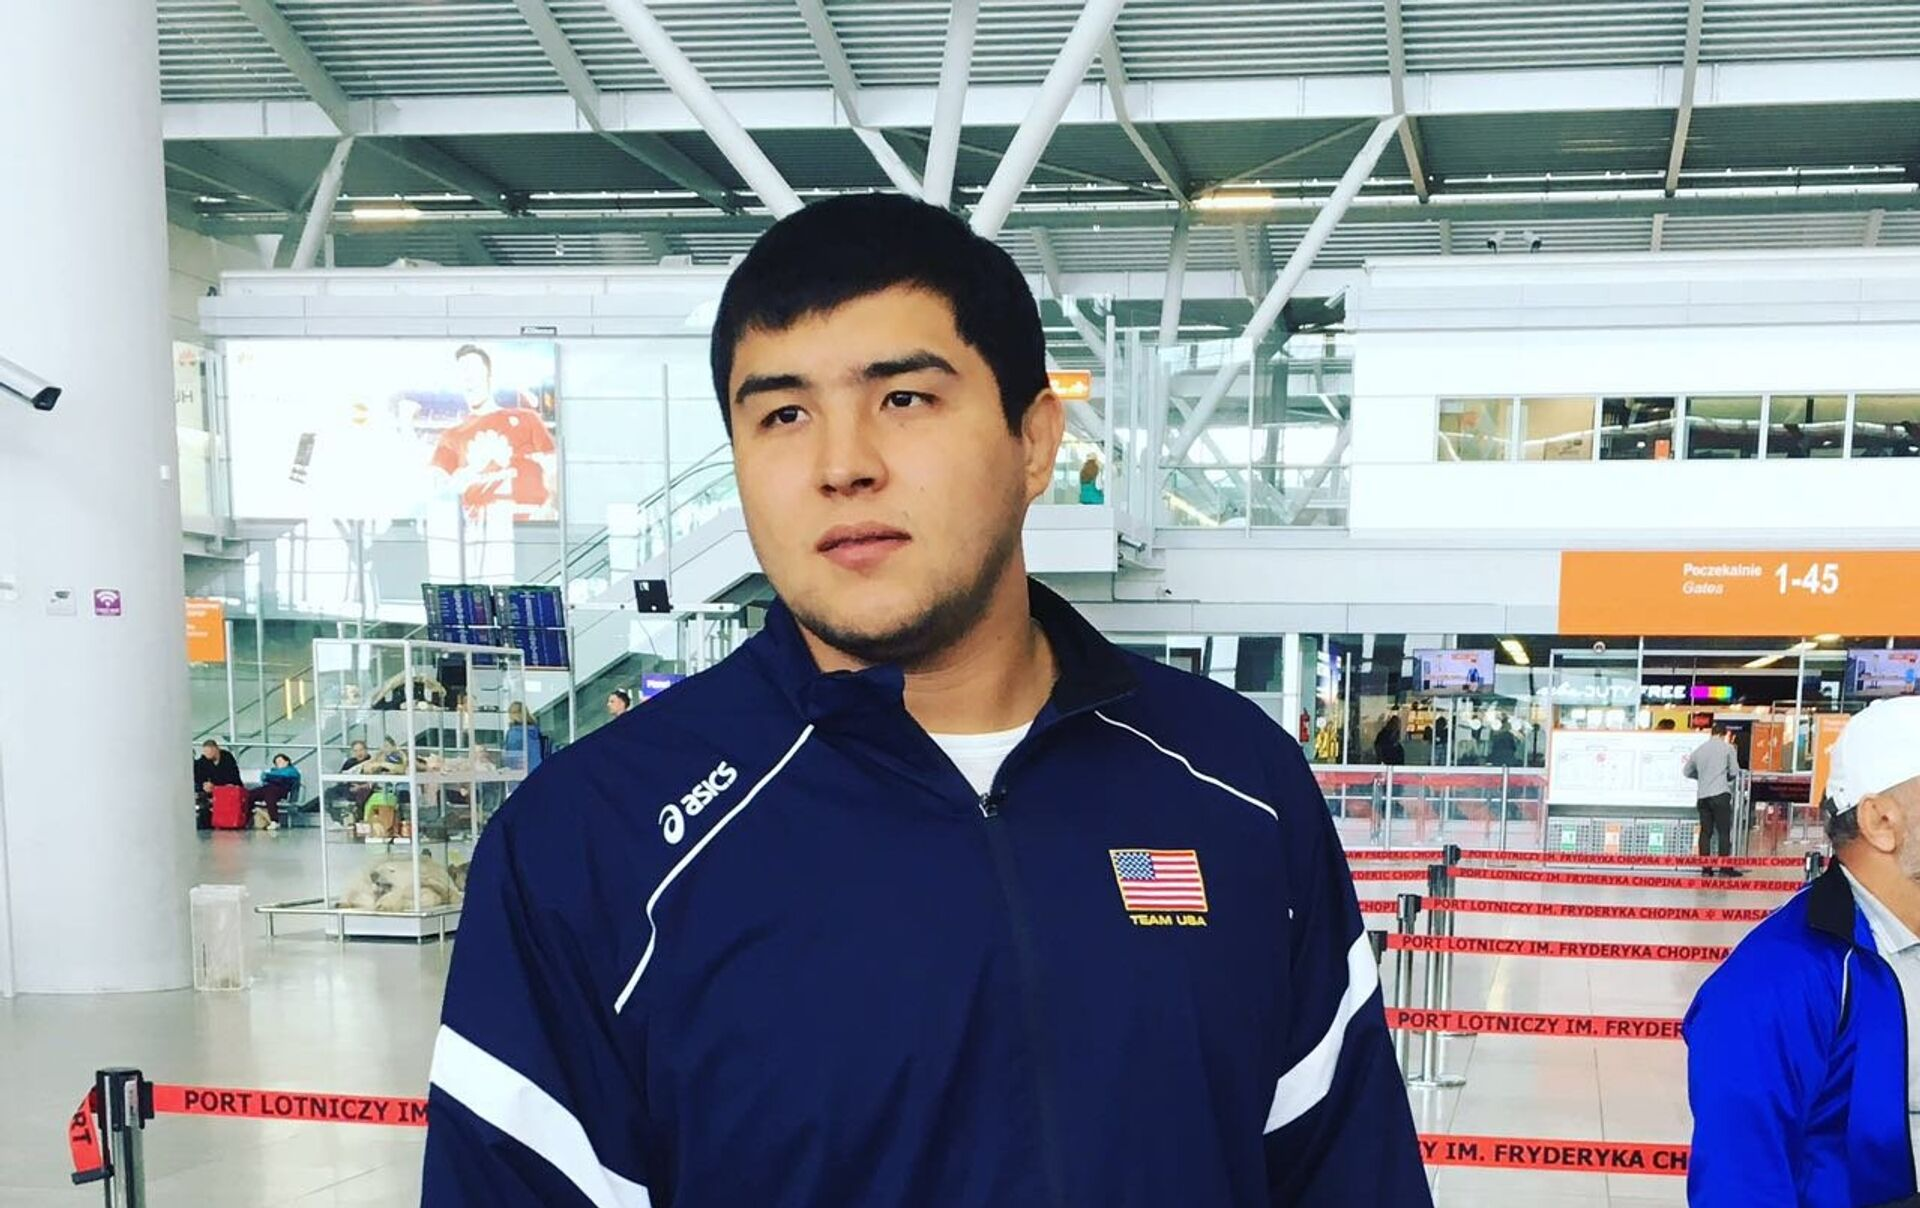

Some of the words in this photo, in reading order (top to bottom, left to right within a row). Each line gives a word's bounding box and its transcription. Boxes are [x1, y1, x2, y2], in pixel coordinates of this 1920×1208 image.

[1682, 581, 1724, 595] Gates
[1683, 562, 1763, 577] Poczekalnie
[1775, 563, 1839, 595] 1-45
[1701, 879, 1751, 890] WARSAW
[1129, 914, 1173, 926] TEAM
[1176, 914, 1207, 927] USA
[1434, 899, 1469, 910] PORT
[1471, 900, 1534, 912] LOTNICZY
[1561, 904, 1636, 918] FRYDERYKA
[1640, 907, 1699, 919] CHOPINA
[1403, 935, 1445, 949] PORT
[1449, 938, 1524, 952] LOTNICZY
[1530, 942, 1554, 954] IM.
[1559, 942, 1651, 958] FRYDERYKA
[1398, 1011, 1452, 1029] PORT
[1458, 1014, 1560, 1034] LOTNICZY
[1567, 1019, 1598, 1035] IM.
[184, 1089, 252, 1114] PORT
[261, 1093, 388, 1121] LOTNICZY
[1446, 1142, 1485, 1161] IM.
[1494, 1144, 1645, 1170] FRYDERYKA
